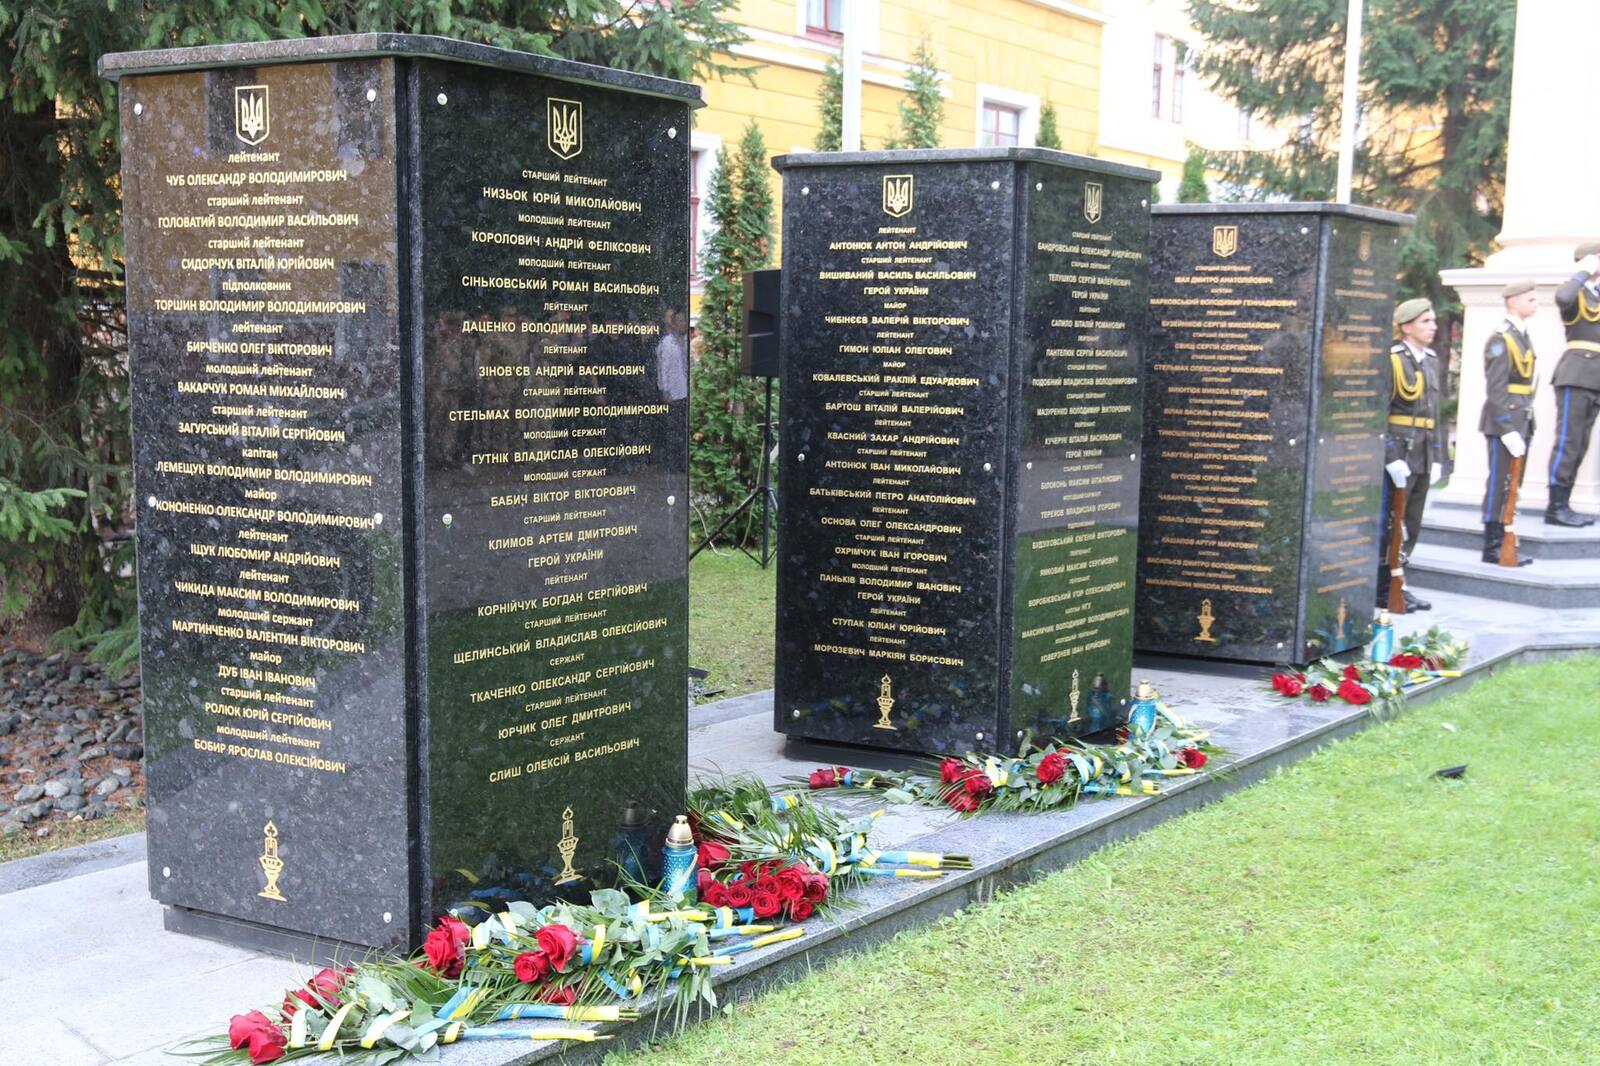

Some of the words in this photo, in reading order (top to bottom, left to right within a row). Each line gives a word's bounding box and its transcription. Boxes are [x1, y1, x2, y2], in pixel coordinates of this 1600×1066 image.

[228, 151, 280, 163] лейтенант
[167, 175, 185, 186] ЧУБ
[188, 173, 246, 186] ОЛЕКСАНДР
[249, 169, 347, 185] ВОЛОДИМИРОВИЧ
[522, 170, 560, 181] СТАРШИЙ
[564, 175, 607, 186] ЛЕЙТЕНАНТ
[207, 194, 249, 208] старший
[252, 193, 303, 205] лейтенант
[484, 187, 527, 201] НИЗЬОК
[533, 192, 560, 204] ЮРІЙ
[566, 196, 641, 212] МИКОЛАЙОВИЧ
[159, 214, 215, 228] ГОЛОВАТИЙ
[218, 215, 285, 229] ВОЛОДИМИР
[288, 211, 358, 226] ВАСИЛЬОВИЧ
[472, 231, 540, 246] КОРОЛОВИЧ
[545, 237, 583, 250] АНДРІЙ
[589, 241, 651, 253] ФЕЛІКСОВИЧ
[830, 242, 872, 250] АНТОНЮК
[909, 240, 967, 250] АНДРІЙОВИЧ
[182, 259, 234, 271] СИДОРЧУК
[237, 256, 275, 270] ВІТАЛІЙ
[278, 256, 334, 270] ЮРІЙОВИЧ
[820, 270, 874, 279] ВИШИВАНИЙ
[915, 271, 976, 279] ВАСИЛЬОВИЧ
[223, 279, 291, 294] підполковник
[462, 276, 547, 289] СІНЬКОВСЬКИЙ
[553, 281, 588, 292] РОМАН
[594, 283, 659, 295] ВАСИЛЬОВИЧ
[864, 286, 890, 295] ГЕРОЙ
[894, 286, 928, 295] УКРАЇНИ
[155, 300, 197, 311] ТОРШИН
[200, 300, 265, 313] ВОЛОДИМИР
[268, 301, 365, 314] ВОЛОДИМИРОВИЧ
[544, 302, 588, 311] ЛЕЙТЕНАНТ
[462, 321, 515, 333] ДАЦЕНКО
[522, 323, 586, 334] ВОЛОДИМИР
[592, 323, 659, 334] ВАЛЕРІЙОВИЧ
[872, 316, 909, 324] ВАЛЕРІЙ
[913, 317, 969, 326] ВІКТОРОВИЧ
[187, 341, 238, 353] БИРЧЕНКО
[240, 343, 265, 354] ОЛЕГ
[268, 344, 332, 356] ВІКТОРОВИЧ
[840, 345, 868, 353] ГИМОН
[905, 347, 952, 355] ОЛЕГОВИЧ
[479, 366, 530, 377] ЗІНОВ'ЄВ
[536, 364, 573, 377] АНДРІЙ
[579, 366, 645, 375] ВАСИЛЬОВИЧ
[813, 374, 880, 382] КОВАЛЕВСЬКИЙ
[884, 375, 916, 384] ІРАКЛІЙ
[921, 377, 979, 386] ЕДУАРДОВИЧ
[178, 382, 227, 394] ВАКАРЧУК
[230, 384, 267, 396] РОМАН
[270, 384, 344, 399] МИХАЙЛОВИЧ
[449, 410, 509, 421] СТЕЛЬМАХ
[516, 408, 580, 420] ВОЛОДИМИР
[584, 405, 668, 417] ВОЛОДИМИРОВИЧ
[826, 403, 861, 411] БАРТОШ
[865, 404, 898, 412] ВІТАЛІЙ
[902, 405, 964, 415] ВАЛЕРІЙОВИЧ
[179, 422, 239, 436] ЗАГУРСЬКИЙ
[241, 424, 280, 440] ВІТАЛІЙ
[282, 427, 345, 442] СЕРГІЙОВИЧ
[524, 429, 568, 439] МОЛОДШИЙ
[572, 428, 606, 437] СЕРЖАНТ
[242, 445, 278, 459] капітан
[473, 453, 508, 464] ГУТНІК
[515, 449, 578, 462] ВЛАДИСЛАВ
[584, 444, 650, 458] ОЛЕКСІЙОВИЧ
[155, 461, 204, 477] ЛЕМЕЩУК
[207, 465, 272, 479] ВОЛОДИМИР
[275, 469, 371, 486] ВОЛОДИМИРОВИЧ
[826, 461, 866, 469] АНТОНЮК
[894, 464, 960, 474] МИКОЛАЙОВИЧ
[245, 488, 277, 502] майор
[491, 495, 527, 506] БАБИЧ
[534, 491, 569, 503] ВІКТОР
[575, 486, 635, 499] ВІКТОРОВИЧ
[810, 488, 871, 498] БАТЬКІВСЬКИЙ
[876, 492, 904, 500] ПЕТРО
[908, 495, 976, 505] АНАТОЛІЙОВИЧ
[157, 499, 214, 515] КОНОНЕНКО
[216, 506, 275, 522] ОЛЕКСАНДР
[278, 509, 374, 530] ВОЛОДИМИРОВИЧ
[886, 522, 961, 534] ОЛЕКСАНДРОВИЧ
[489, 536, 533, 550] КЛИМОВ
[539, 532, 572, 544] АРТЕМ
[578, 525, 637, 542] ДМИТРОВИЧ
[191, 544, 215, 557] ІЩУК
[218, 547, 271, 561] ЛЮБОМИР
[273, 552, 340, 568] АНДРІЙОВИЧ
[529, 553, 560, 568] ГЕРОЙ
[565, 549, 603, 563] УКРАЇНИ
[175, 581, 215, 597] ЧИКИДА
[217, 586, 261, 600] МАКСИМ
[264, 591, 359, 611] ВОЛОДИМИРОВИЧ
[478, 600, 537, 616] КОРНІЙЧУК
[543, 593, 582, 607] БОГДАН
[588, 583, 647, 600] СЕРГІЙОВИЧ
[218, 608, 270, 622] молодший
[272, 615, 313, 627] сержант
[833, 618, 864, 627] СТУПАК
[868, 622, 895, 630] ЮЛІАН
[900, 625, 946, 635] ЮРІЙОВИЧ
[173, 620, 243, 638] МАРТИНЧЕНКО
[246, 629, 298, 645] ВАЛЕНТИН
[301, 636, 364, 653] ВІКТОРОВИЧ
[454, 640, 530, 664] ЩЕЛИНСЬКИЙ
[536, 630, 597, 649] ВЛАДИСЛАВ
[602, 618, 666, 637] ОЛЕКСІЙОВИЧ
[550, 653, 584, 666] СЕРЖАНТ
[815, 645, 865, 655] МОРОЗЕВИЧ
[869, 650, 905, 660] МАРКІЯН
[910, 654, 963, 666] БОРИСОВИЧ
[218, 665, 238, 678] ДУБ
[240, 669, 262, 682] ІВАН
[265, 672, 315, 688] ІВАНОВИЧ
[470, 684, 526, 703] ТКАЧЕНКО
[531, 672, 591, 691] ОЛЕКСАНДР
[596, 659, 654, 678] СЕРГІЙОВИЧ
[205, 702, 241, 717] РОЛЮК
[243, 708, 268, 721] ЮРІЙ
[271, 712, 331, 731] СЕРГІЙОВИЧ
[499, 723, 536, 739] ЮРЧИК
[541, 716, 567, 729] ОЛЕГ
[572, 702, 631, 725] ДМИТРОВИЧ
[195, 739, 226, 753] БОБИР
[229, 745, 273, 761] ЯРОСЛАВ
[275, 752, 345, 773] ОЛЕКСІЙОВИЧ
[490, 767, 521, 782] СЛИШ
[527, 753, 569, 773] ОЛЕКСІЙ
[575, 738, 639, 761] ВАСИЛЬОВИЧ
